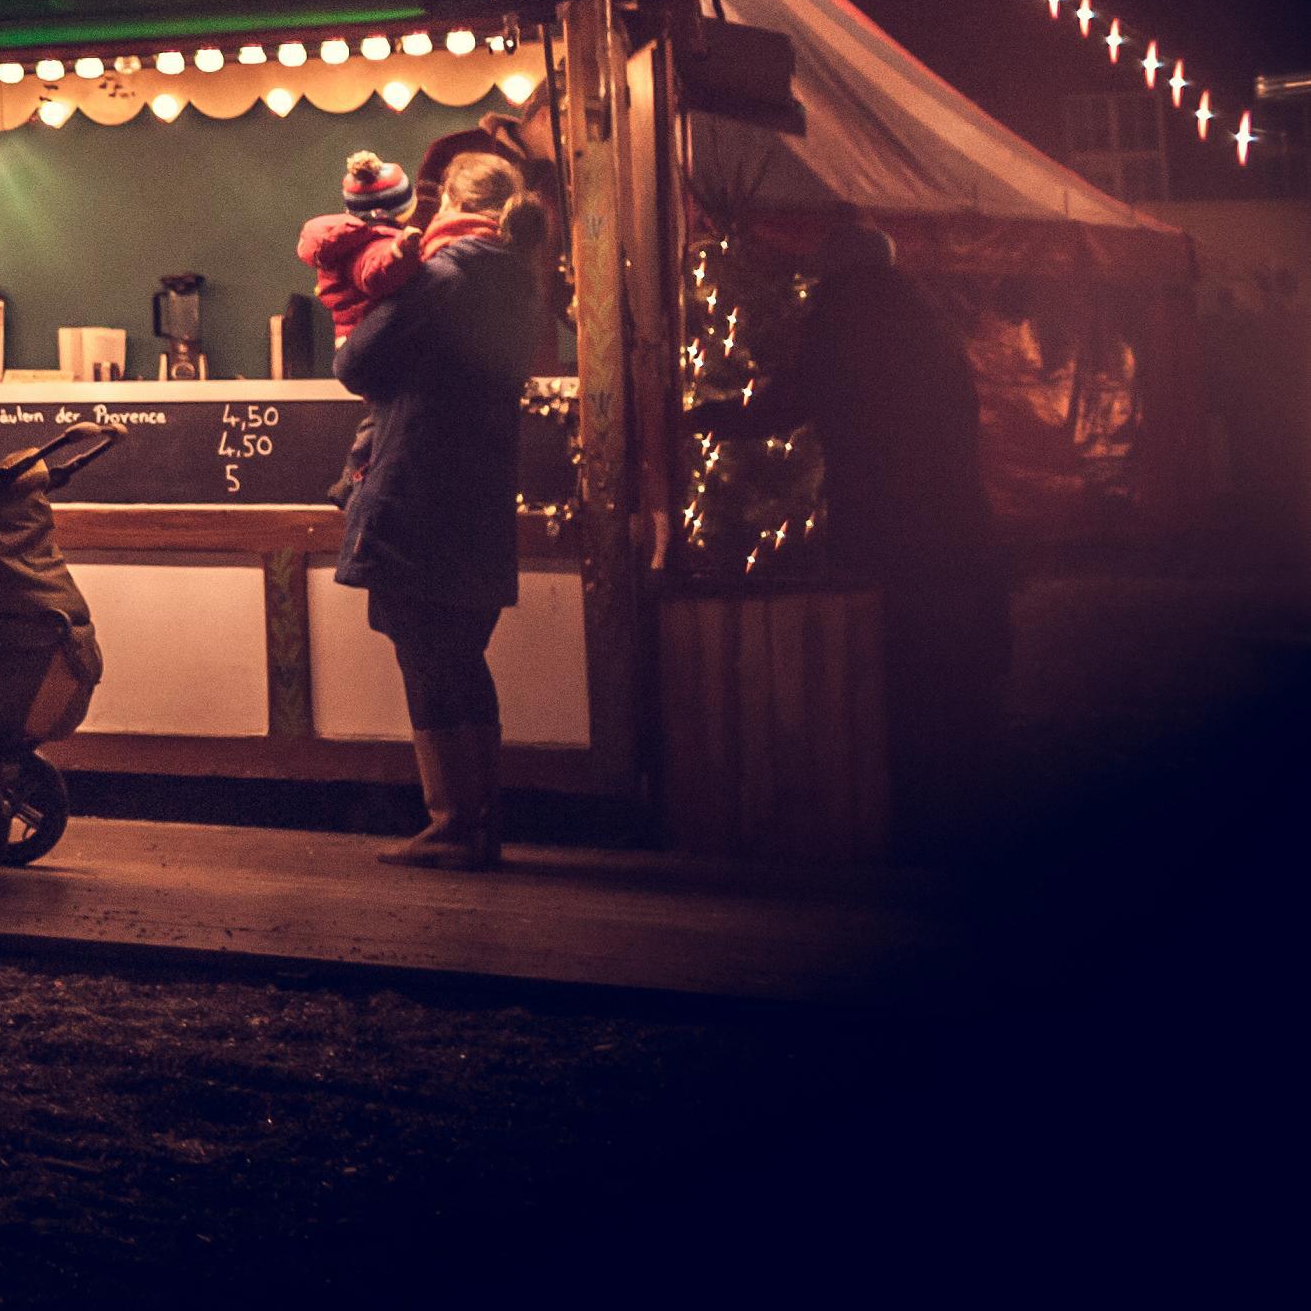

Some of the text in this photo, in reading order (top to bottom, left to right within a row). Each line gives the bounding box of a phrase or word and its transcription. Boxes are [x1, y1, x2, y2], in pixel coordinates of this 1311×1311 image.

[55, 406, 82, 424] der
[92, 404, 167, 425] Provence
[222, 404, 279, 431] 4,50
[224, 464, 242, 492] 5
